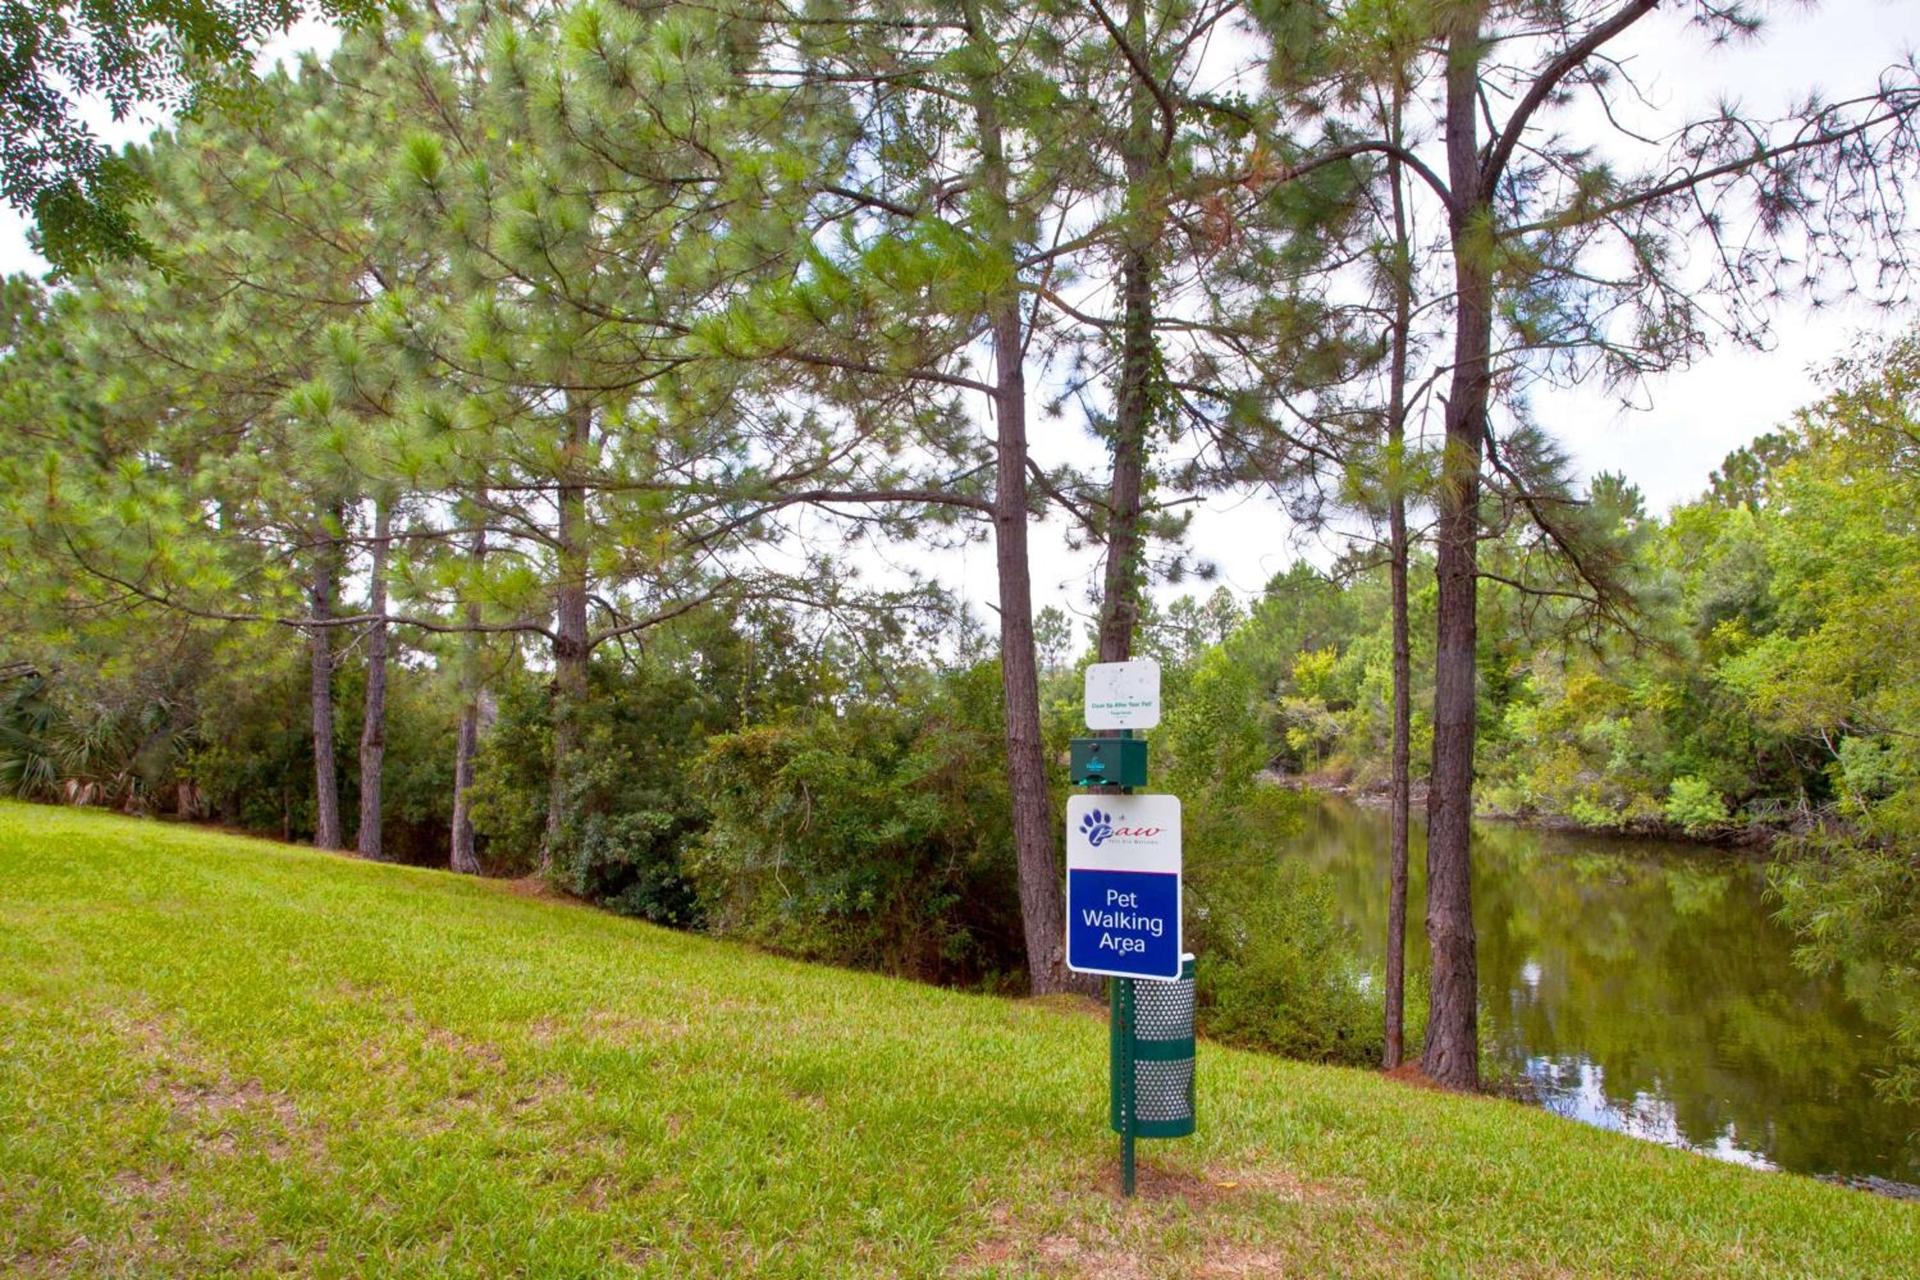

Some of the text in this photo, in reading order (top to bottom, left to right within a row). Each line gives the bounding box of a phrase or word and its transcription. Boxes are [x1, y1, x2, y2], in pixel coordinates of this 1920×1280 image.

[1106, 889, 1138, 908] Pet
[1082, 909, 1163, 937] Walking
[1099, 932, 1145, 953] Area
